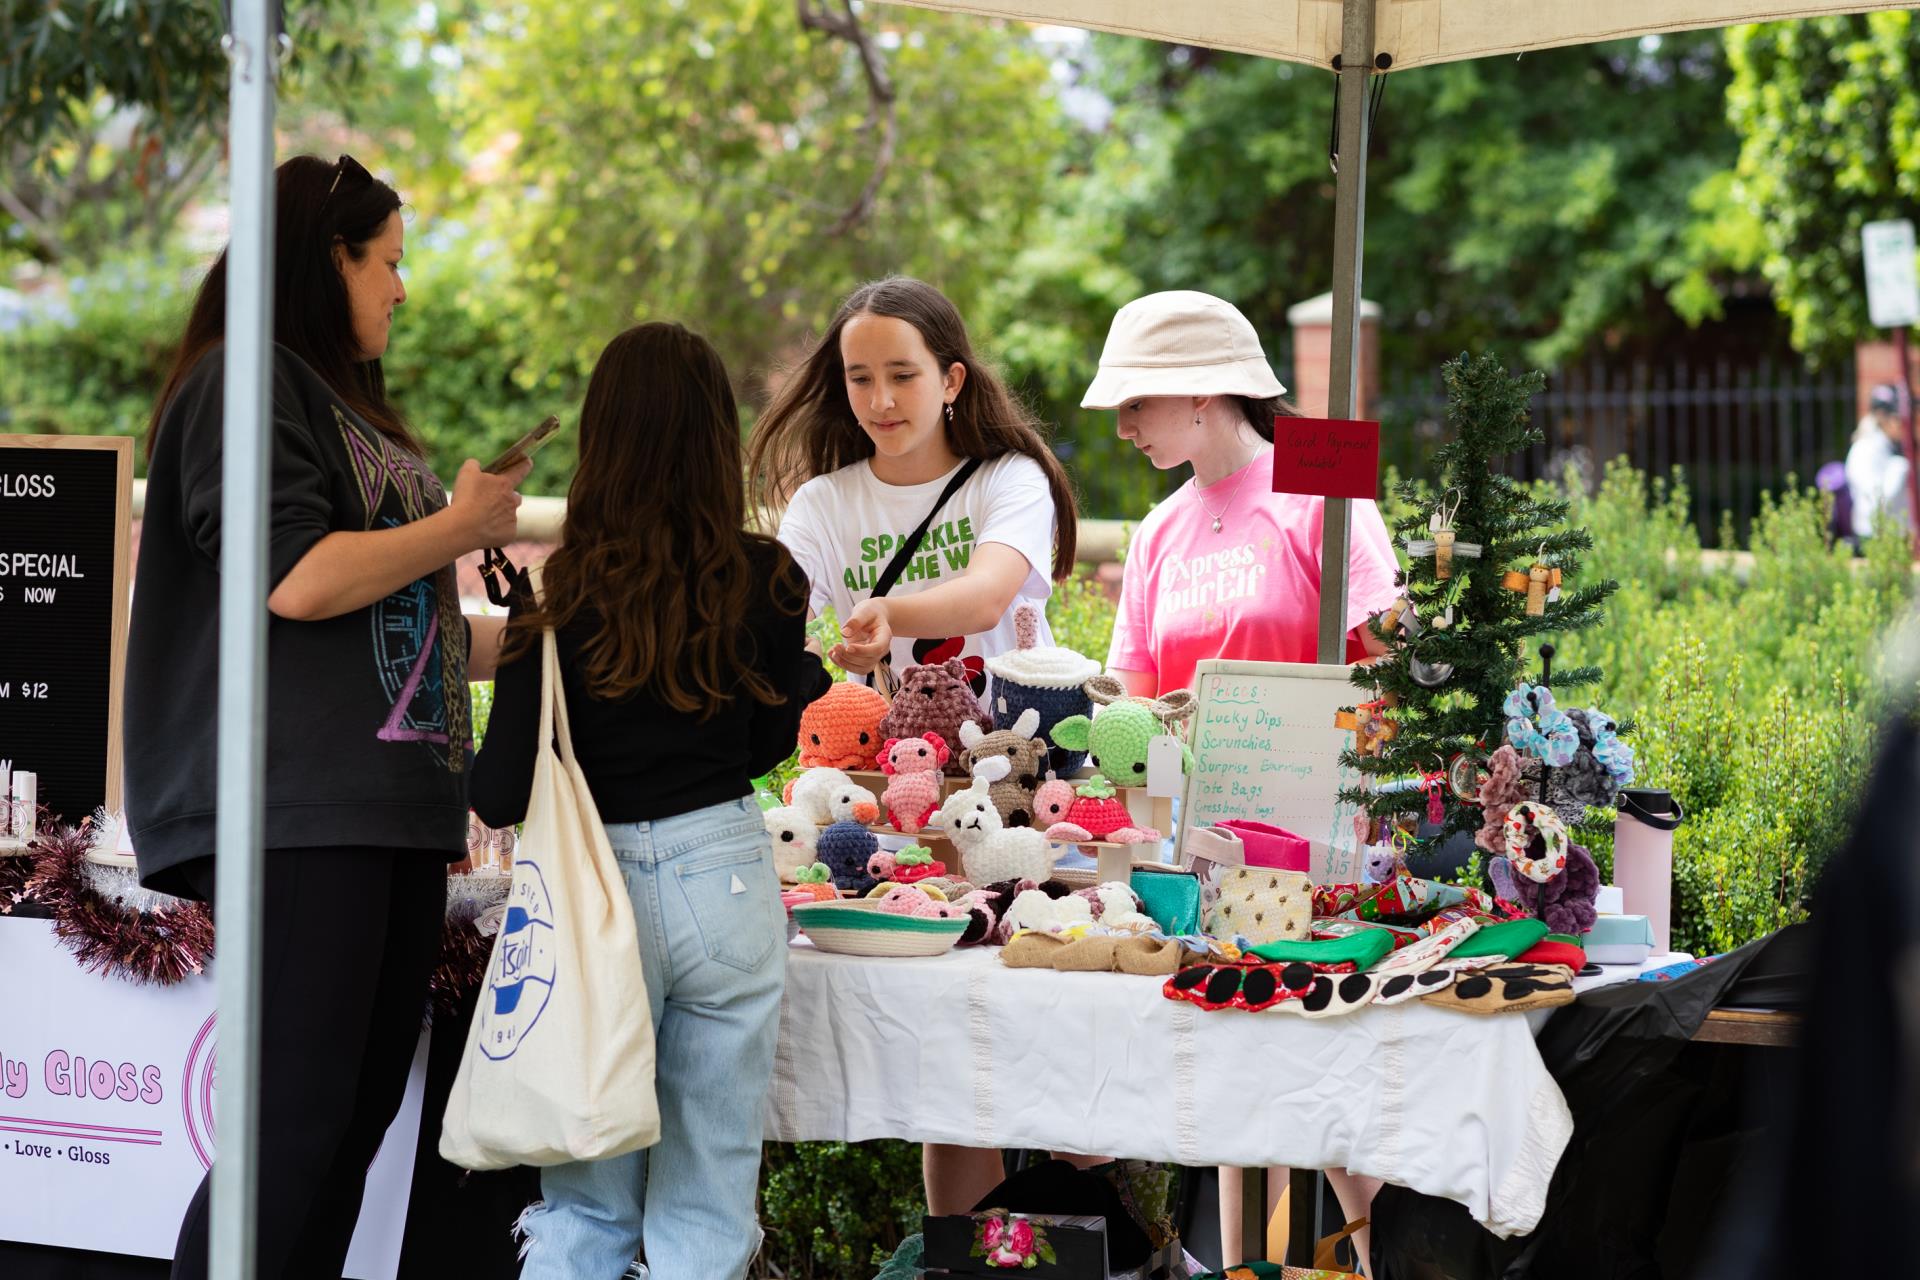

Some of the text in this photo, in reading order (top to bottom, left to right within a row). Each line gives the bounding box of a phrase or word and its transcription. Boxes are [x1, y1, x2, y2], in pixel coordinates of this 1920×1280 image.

[1287, 430, 1372, 455] Card Payment
[0, 473, 56, 498] LOSS
[860, 516, 975, 563] SPARKLE
[0, 552, 85, 578] SPECIAL
[895, 553, 941, 586] HE
[1160, 543, 1256, 588] Express
[25, 587, 56, 604] NOW
[21, 681, 49, 699] $12
[1206, 708, 1249, 732] Lucky
[1201, 729, 1272, 752] Scrunchies
[1198, 753, 1249, 777] Surprise
[1260, 759, 1313, 780] Earrings
[1195, 779, 1264, 802] Tote Bags
[1325, 857, 1351, 876] $15
[44, 1049, 163, 1105] Gloss
[15, 1139, 111, 1165] Love Gloss
